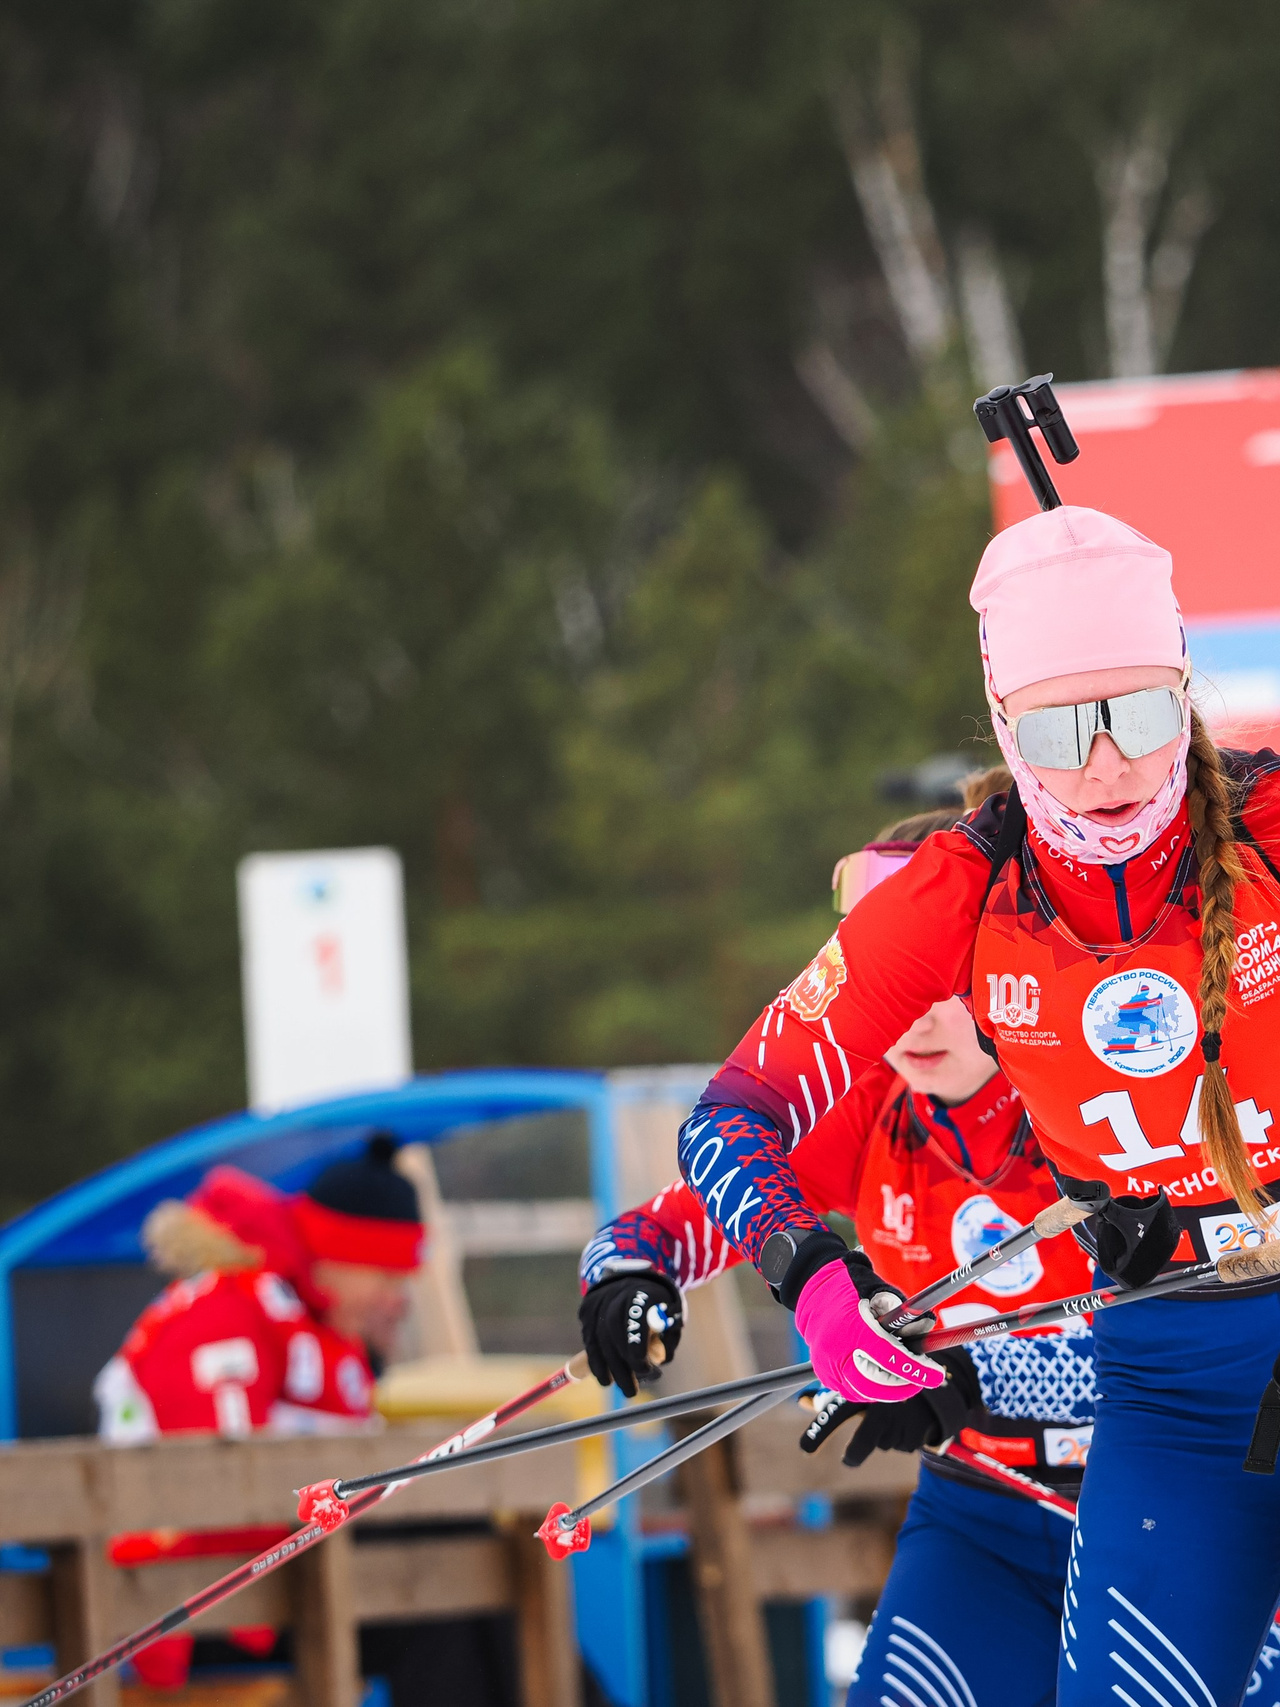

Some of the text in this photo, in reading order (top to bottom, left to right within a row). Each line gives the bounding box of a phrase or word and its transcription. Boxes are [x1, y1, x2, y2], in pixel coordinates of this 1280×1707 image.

[1234, 923, 1265, 953] ОРТ
[1028, 988, 1041, 996] ЛЕТ
[1086, 971, 1178, 1010] ПЕРВЕНСТВО РОССИИ
[1243, 987, 1275, 1007] ПРОЕКТ
[1030, 1031, 1057, 1039] СПОРТА
[1020, 1038, 1061, 1047] ФЕДЕРАЦИИ
[1114, 1060, 1166, 1073] Красноярск
[1079, 1066, 1274, 1172] 14
[627, 1290, 649, 1344] MOAX
[974, 1326, 986, 1336] PRO
[985, 1323, 999, 1333] TEAM
